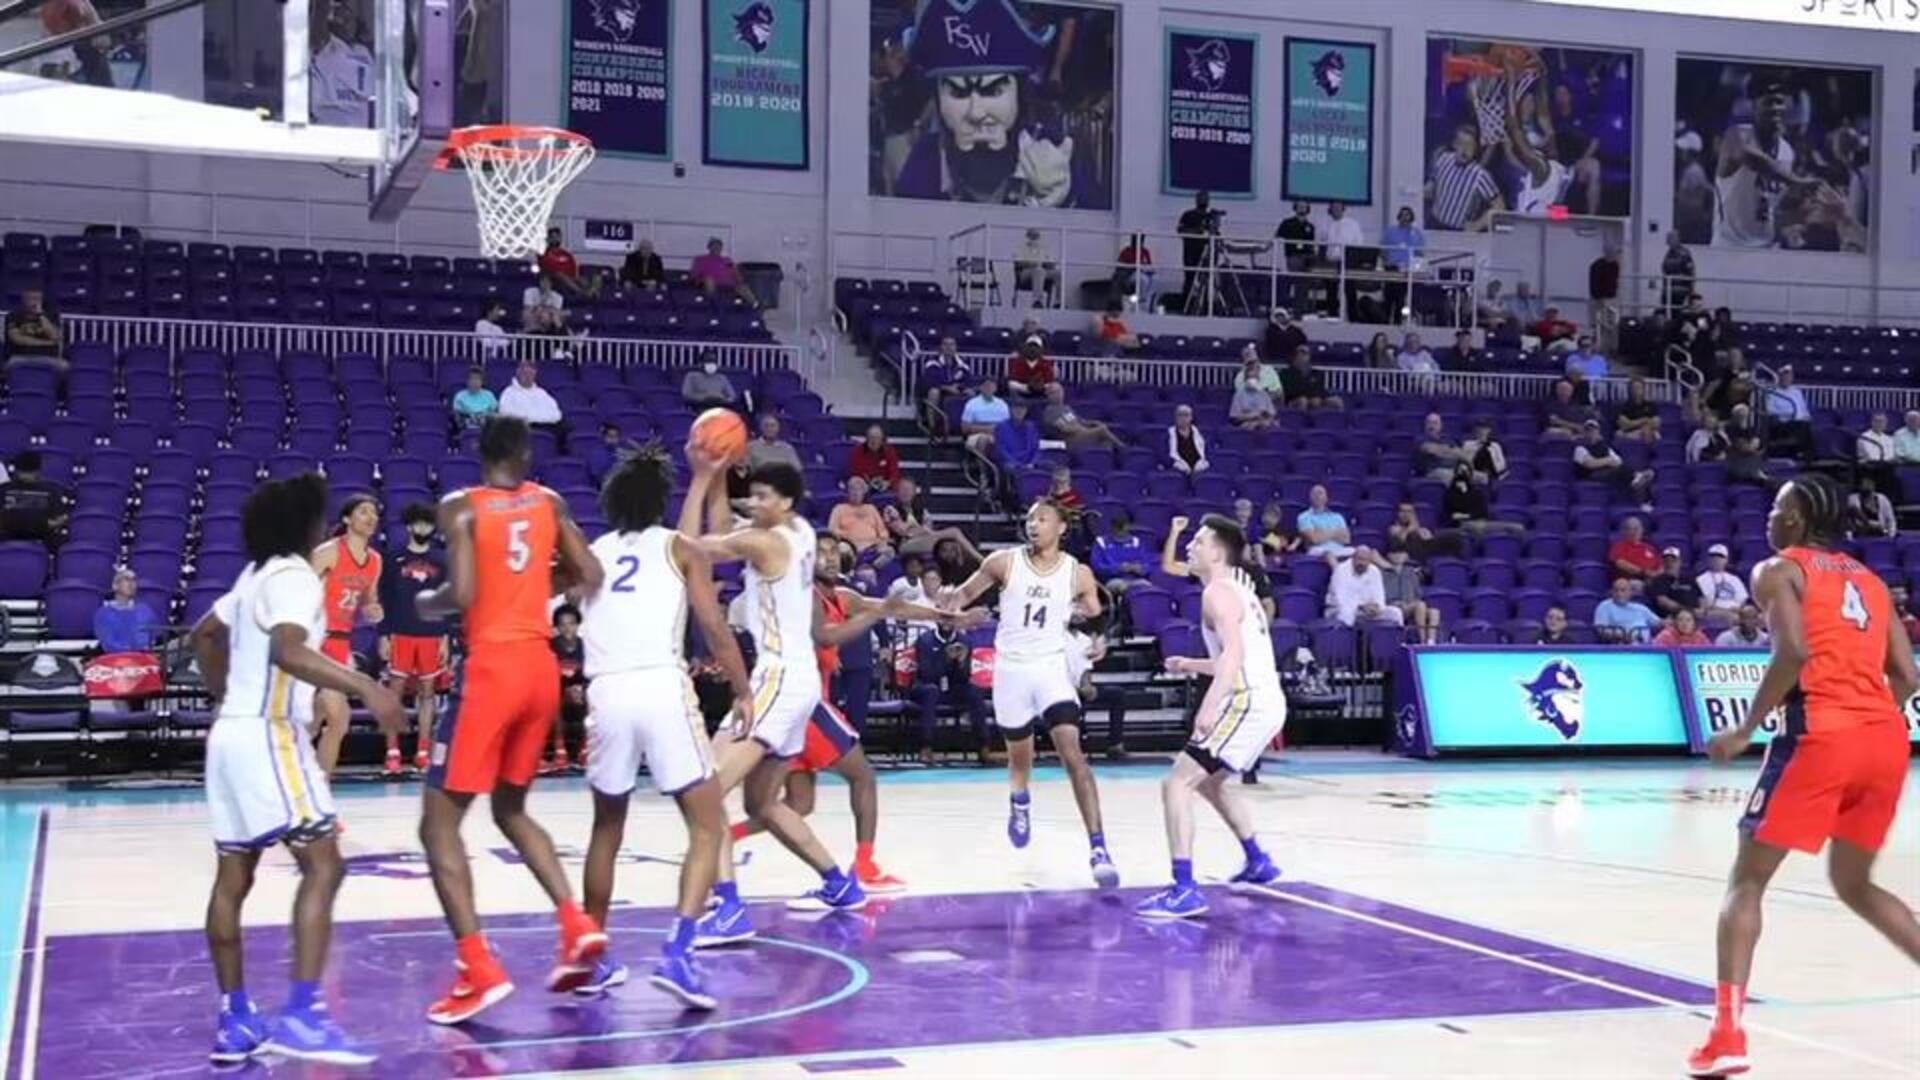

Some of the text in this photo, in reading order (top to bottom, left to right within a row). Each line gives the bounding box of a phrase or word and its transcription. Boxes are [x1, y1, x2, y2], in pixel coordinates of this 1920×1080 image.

[944, 16, 990, 56] FSW
[759, 95, 801, 111] 2020
[603, 223, 625, 238] 116
[507, 519, 531, 574] 5
[611, 555, 640, 592] 2
[338, 587, 362, 610] 25
[1841, 580, 1869, 631] 4
[1023, 602, 1047, 629] 14
[1698, 664, 1766, 684] FLORID
